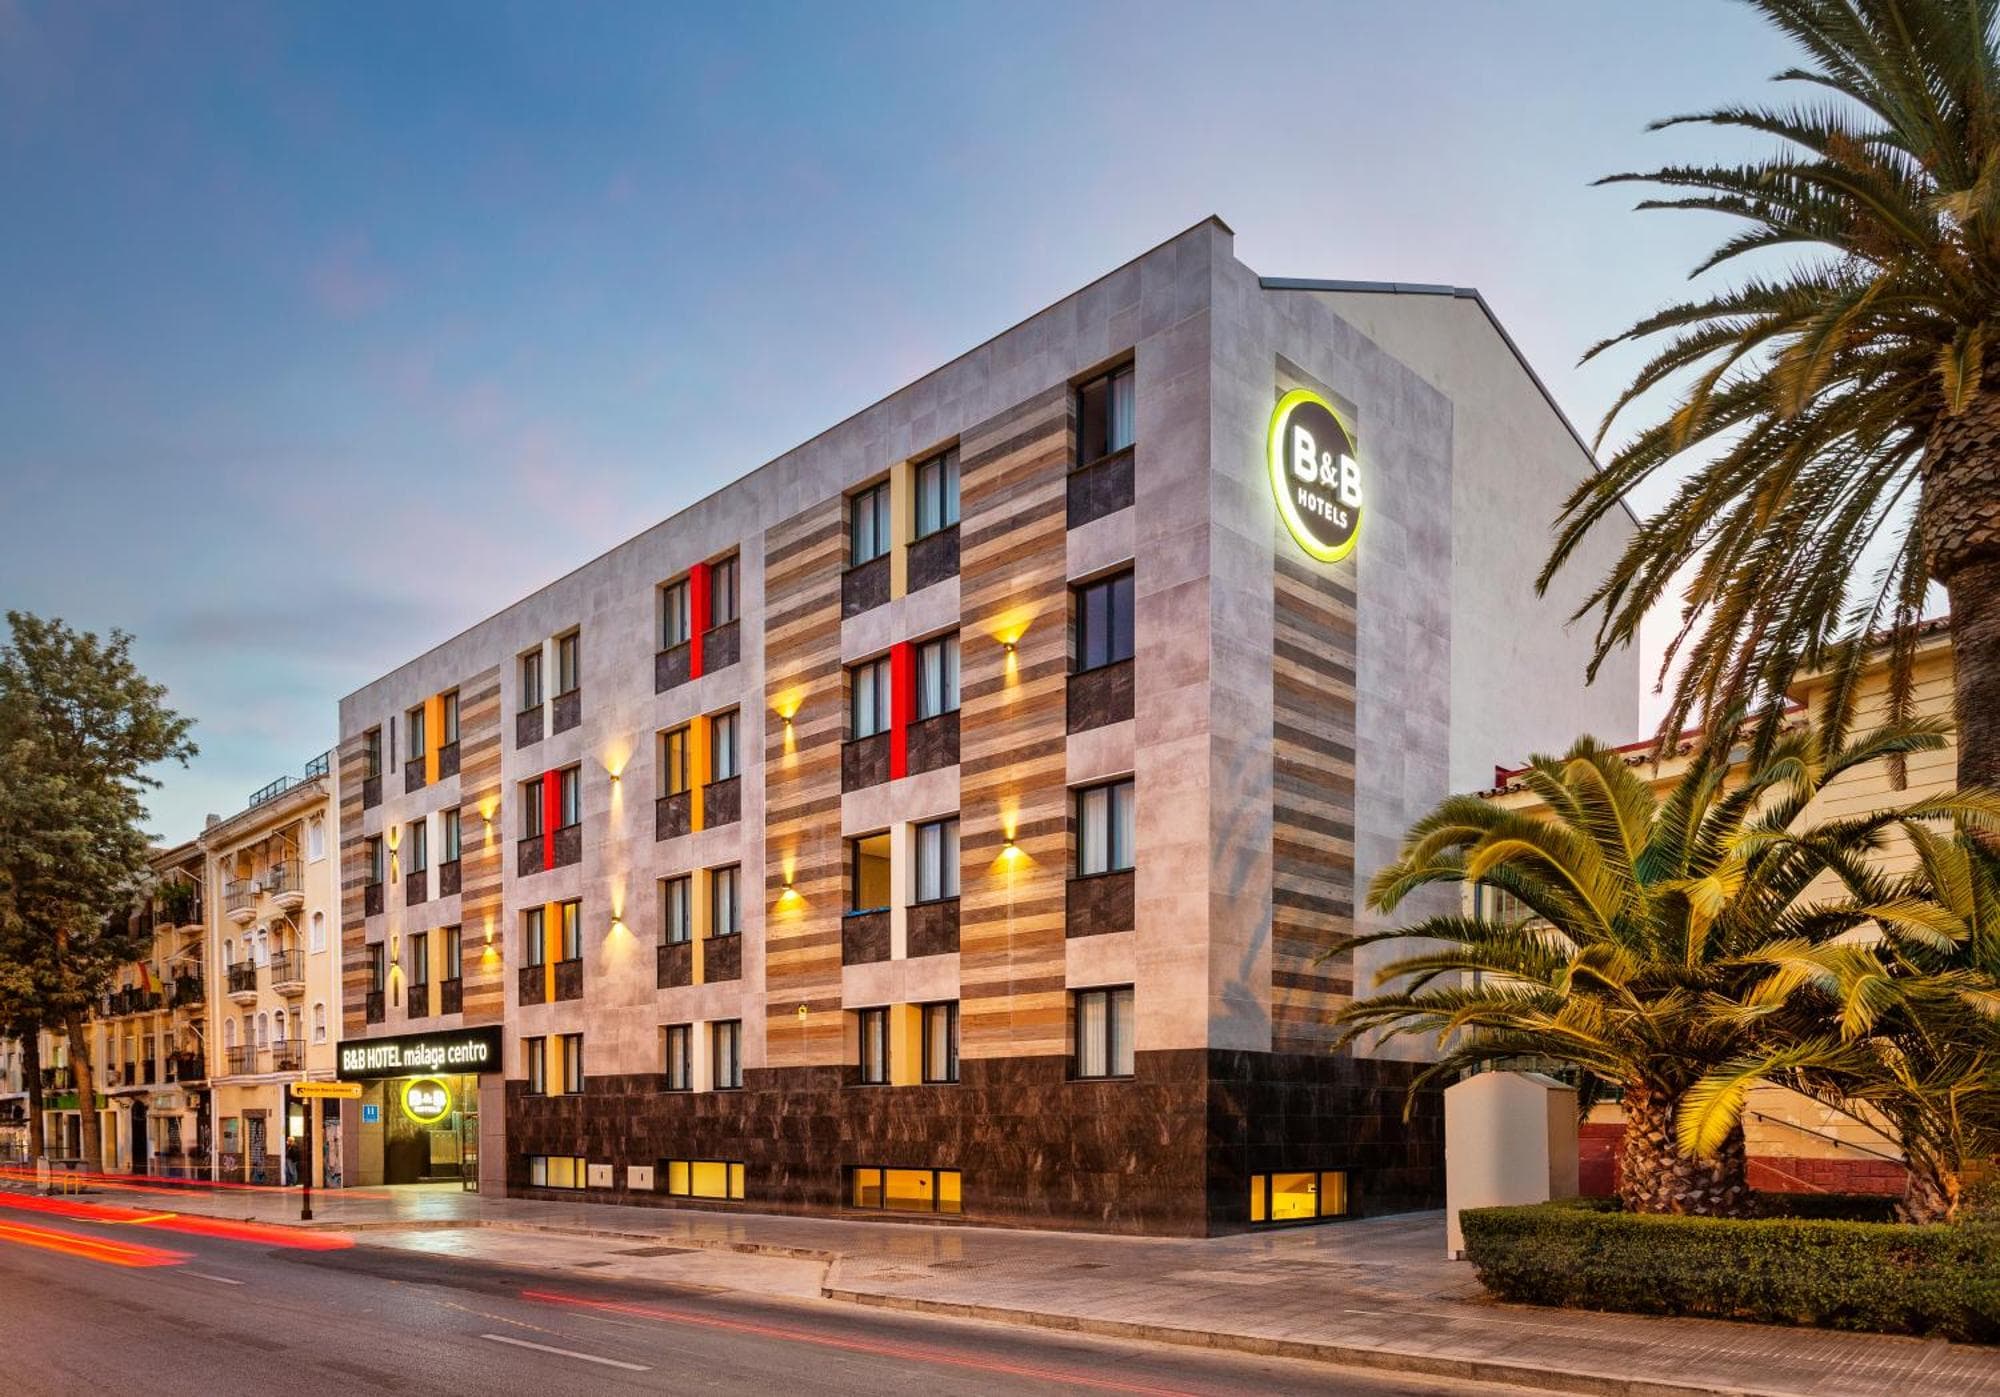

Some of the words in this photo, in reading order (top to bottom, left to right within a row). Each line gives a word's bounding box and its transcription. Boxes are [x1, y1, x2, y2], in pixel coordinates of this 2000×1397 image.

[1293, 425, 1363, 508] B&B
[1298, 487, 1348, 529] HOTELS
[343, 1050, 366, 1071] B&B
[367, 1046, 402, 1068] HOTEL
[404, 1043, 446, 1070] málaga
[448, 1040, 487, 1063] centro
